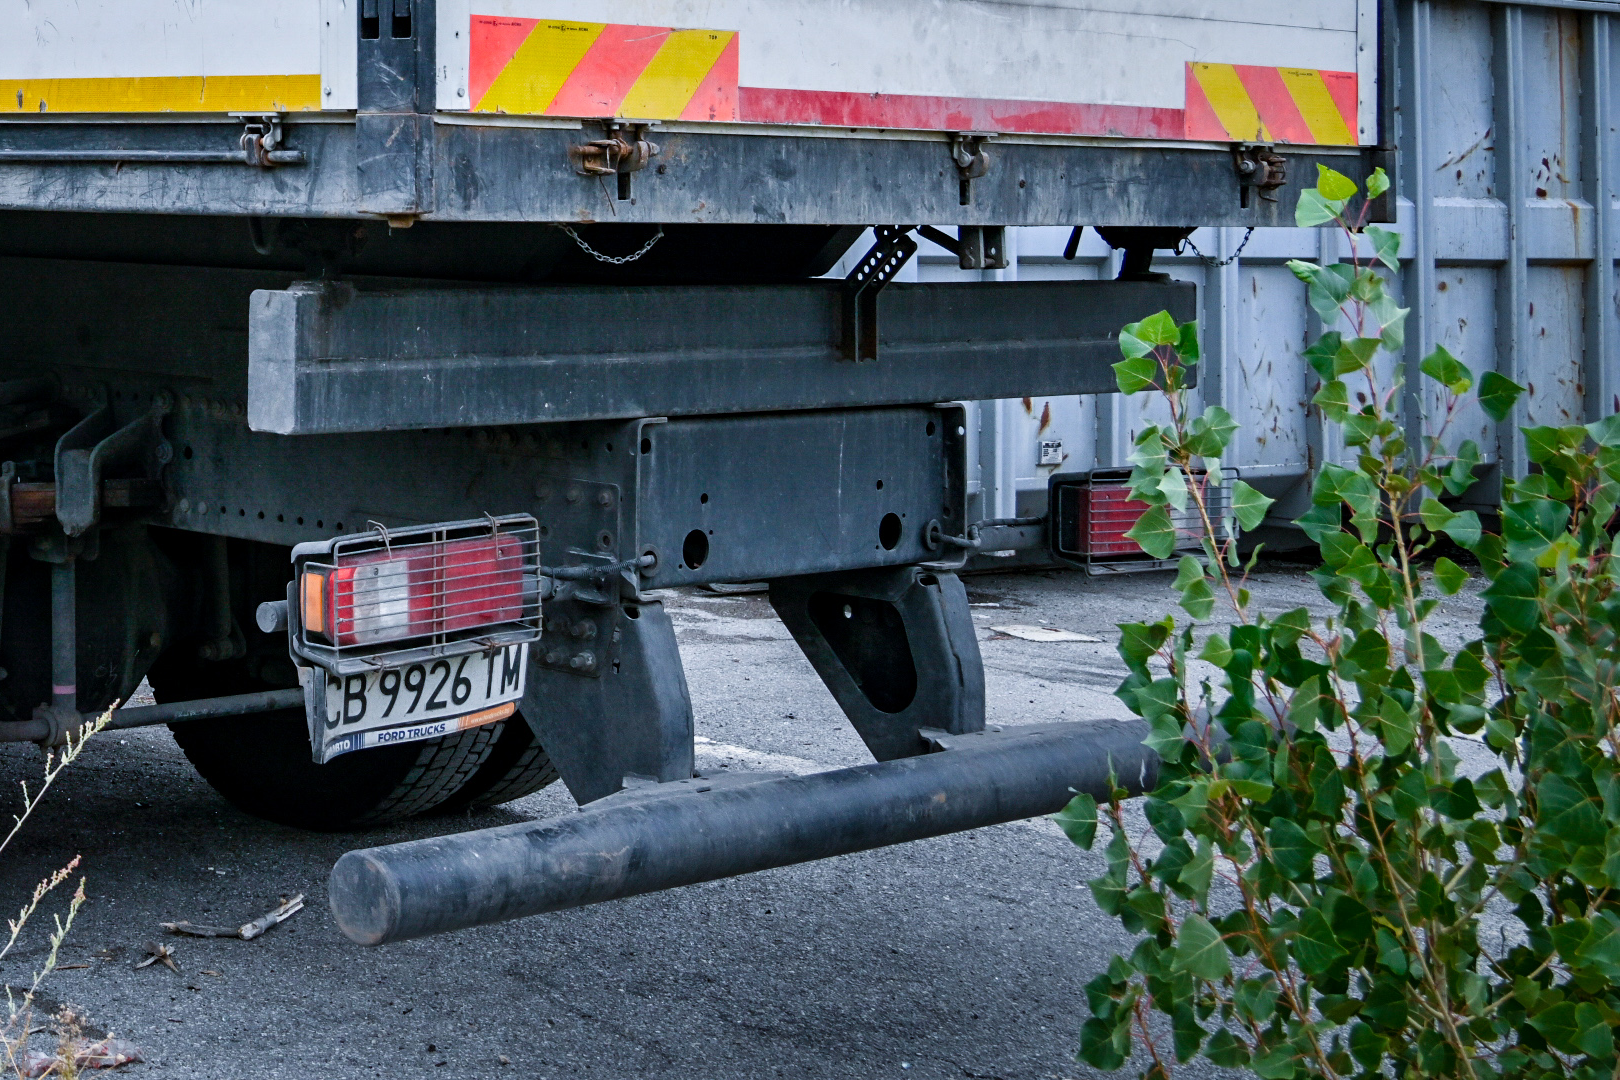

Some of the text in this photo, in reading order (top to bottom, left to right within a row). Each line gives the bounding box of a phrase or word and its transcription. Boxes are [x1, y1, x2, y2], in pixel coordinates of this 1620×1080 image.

[326, 643, 523, 730] CB 9926 TM
[377, 723, 446, 743] FORD TRUCKS
